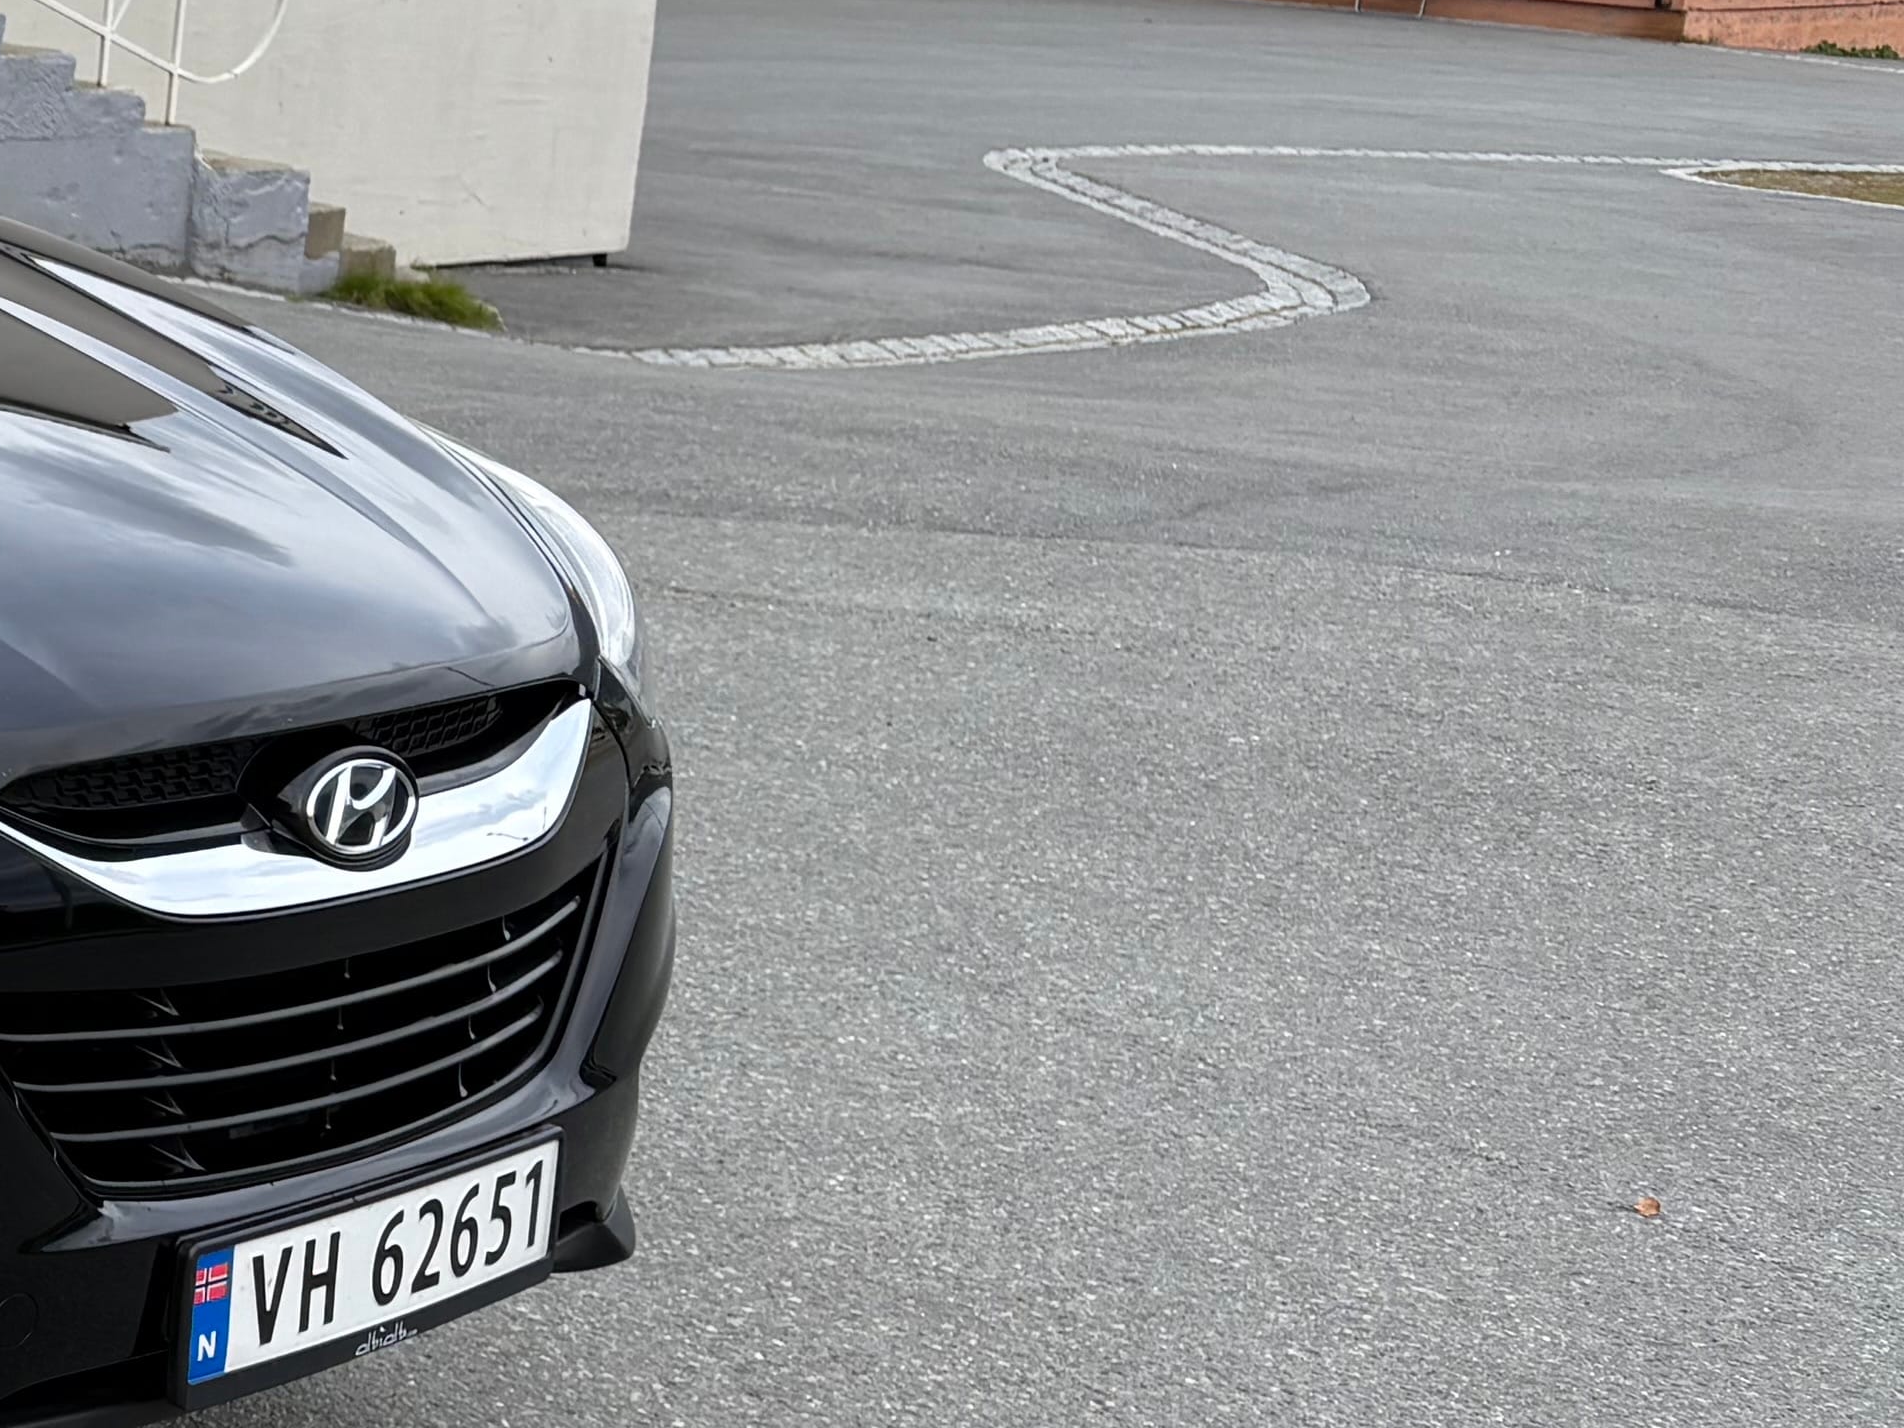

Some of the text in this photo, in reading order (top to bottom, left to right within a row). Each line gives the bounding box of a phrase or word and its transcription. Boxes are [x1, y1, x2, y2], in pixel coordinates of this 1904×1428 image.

[252, 1159, 544, 1347] VH 62651
[197, 1329, 217, 1362] N
